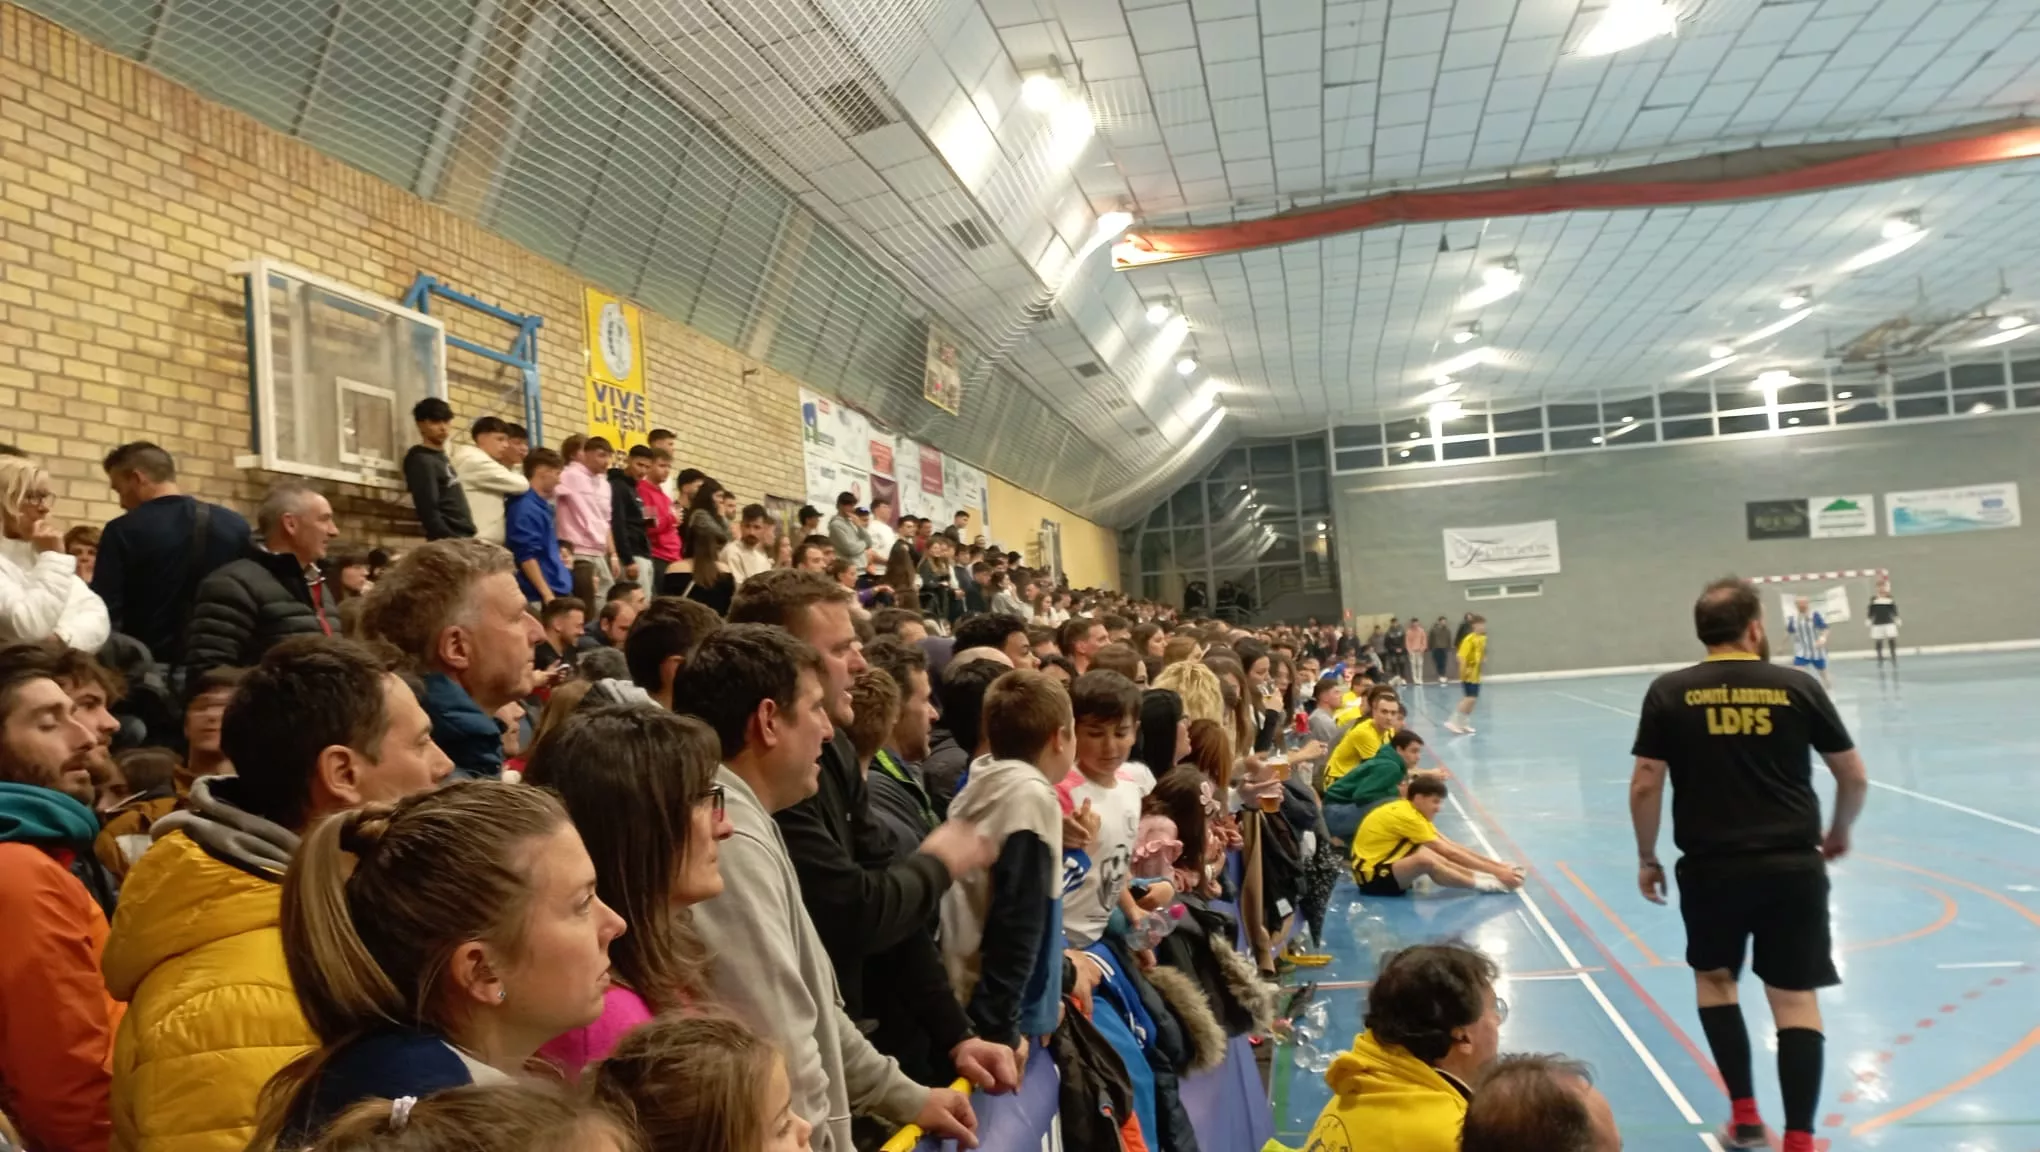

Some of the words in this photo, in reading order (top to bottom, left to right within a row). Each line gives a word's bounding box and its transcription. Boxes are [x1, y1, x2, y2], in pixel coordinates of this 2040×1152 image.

[592, 381, 646, 415] VIVE
[592, 402, 608, 424] LA
[1685, 683, 1728, 705] COMITÉ
[1731, 688, 1790, 706] ARBITRAL
[1706, 707, 1772, 735] LDFS
